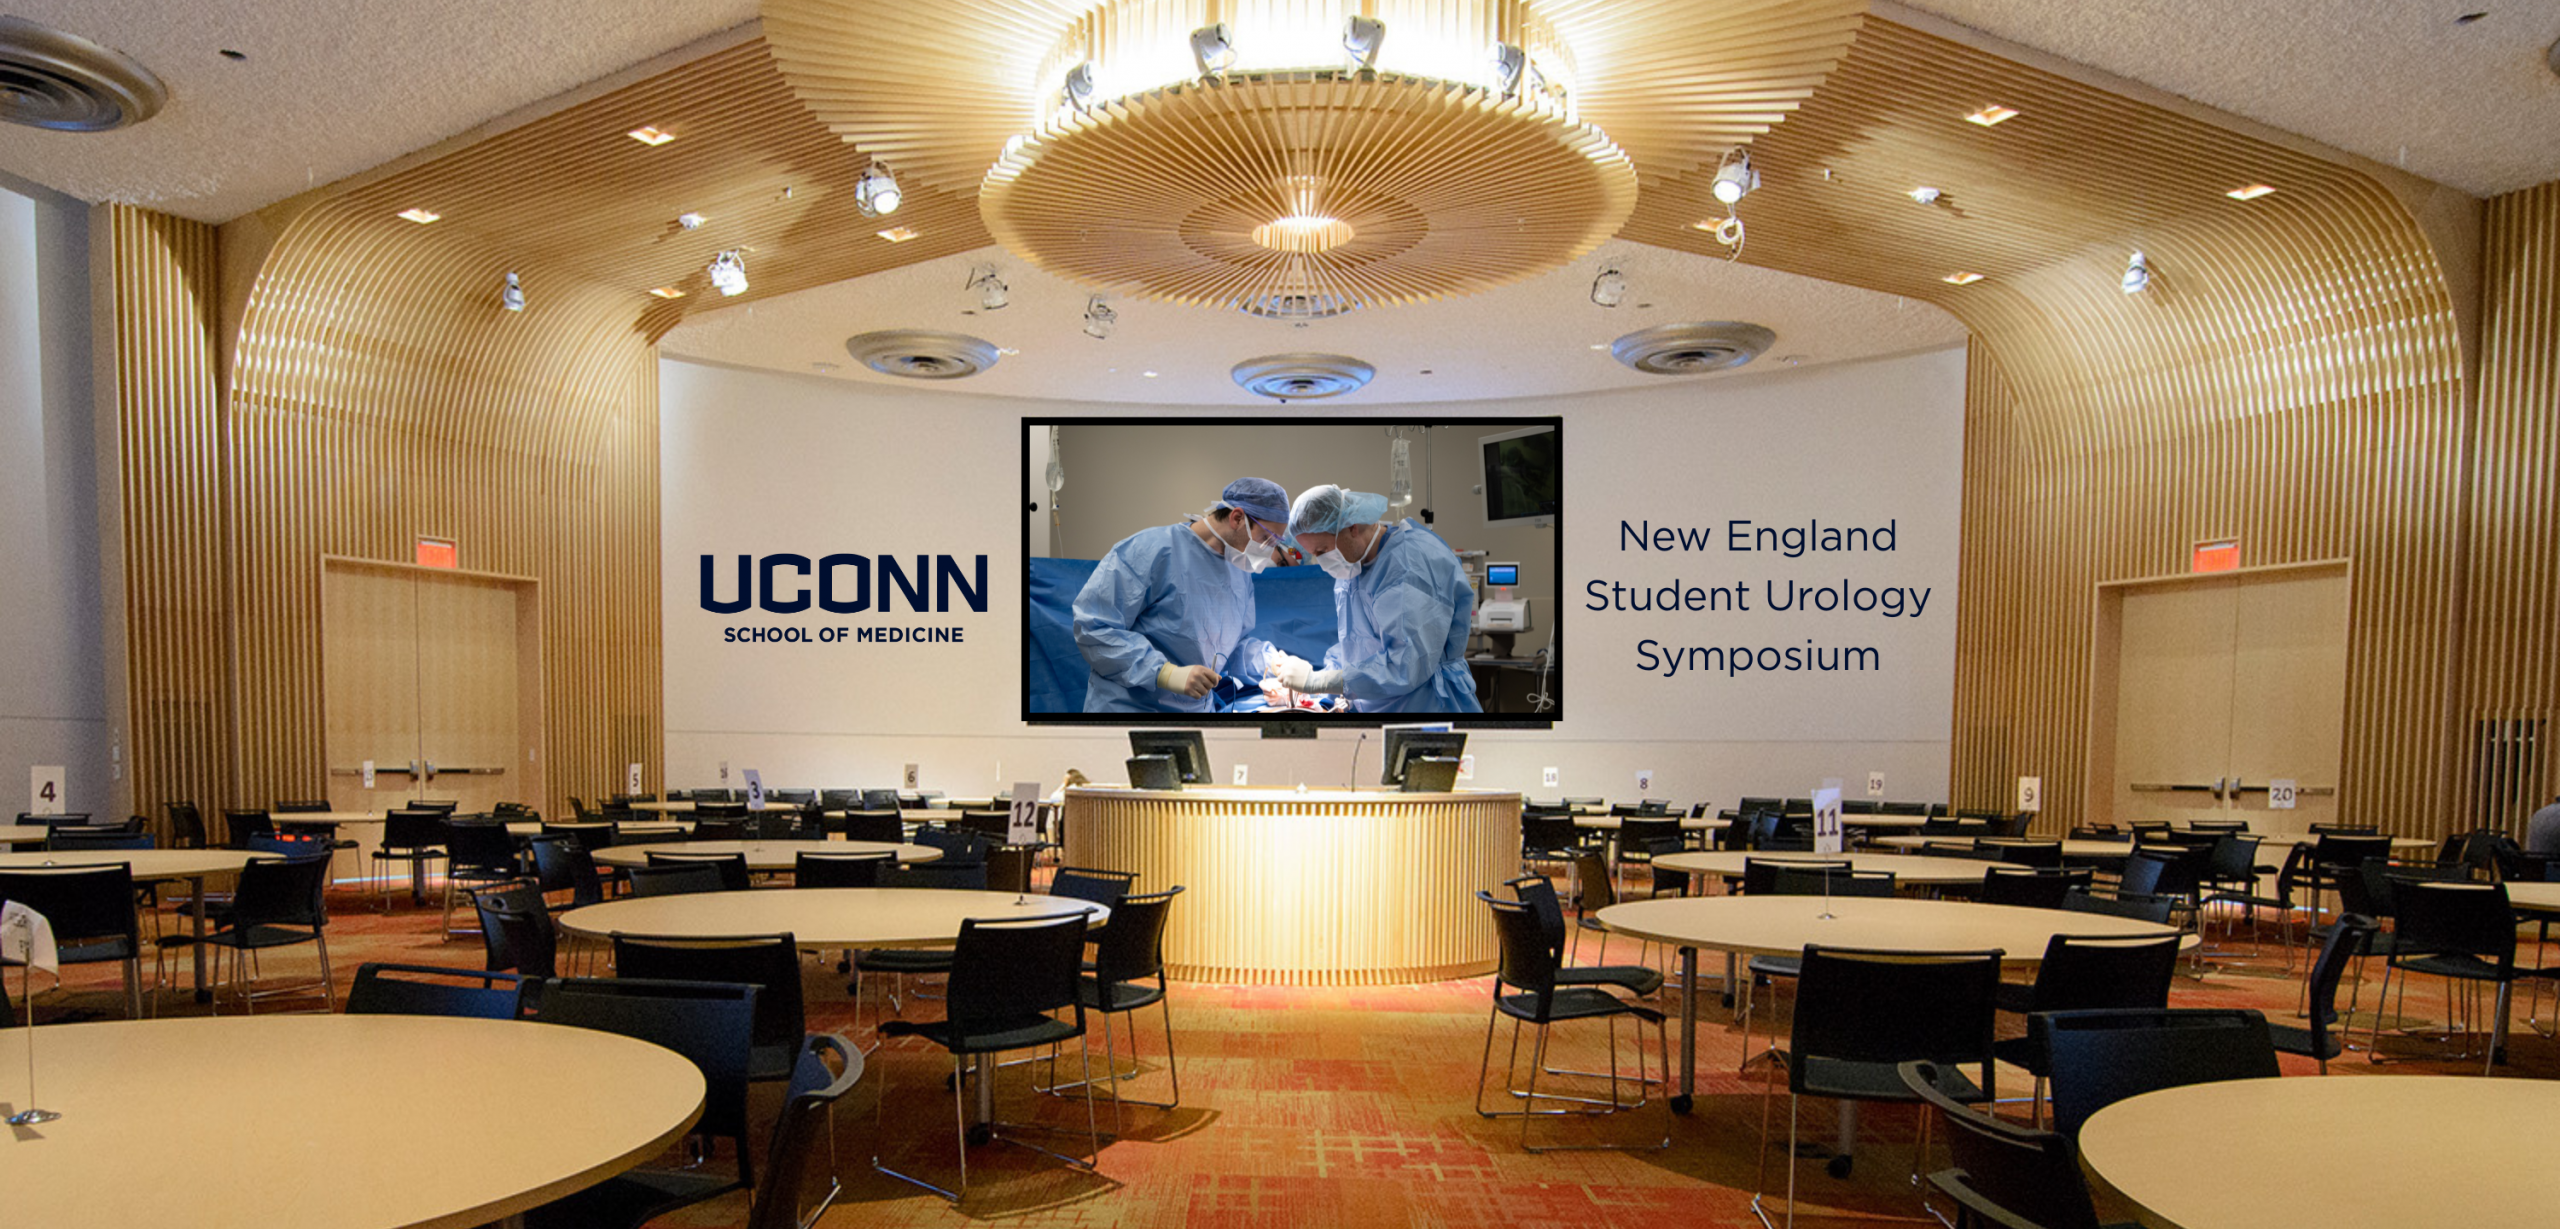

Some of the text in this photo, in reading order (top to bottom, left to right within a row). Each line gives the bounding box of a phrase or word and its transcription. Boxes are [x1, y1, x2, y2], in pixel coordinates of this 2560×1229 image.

[633, 773, 639, 787] 5
[907, 771, 915, 783] 6
[1237, 770, 1244, 779] 7
[752, 781, 760, 799] 3
[1640, 777, 1648, 790] 8
[1870, 779, 1882, 790] 19
[40, 781, 56, 802] 4
[2024, 787, 2034, 802] 9
[2272, 786, 2292, 802] 20
[1012, 801, 1035, 827] 12
[1817, 808, 1839, 837] 11
